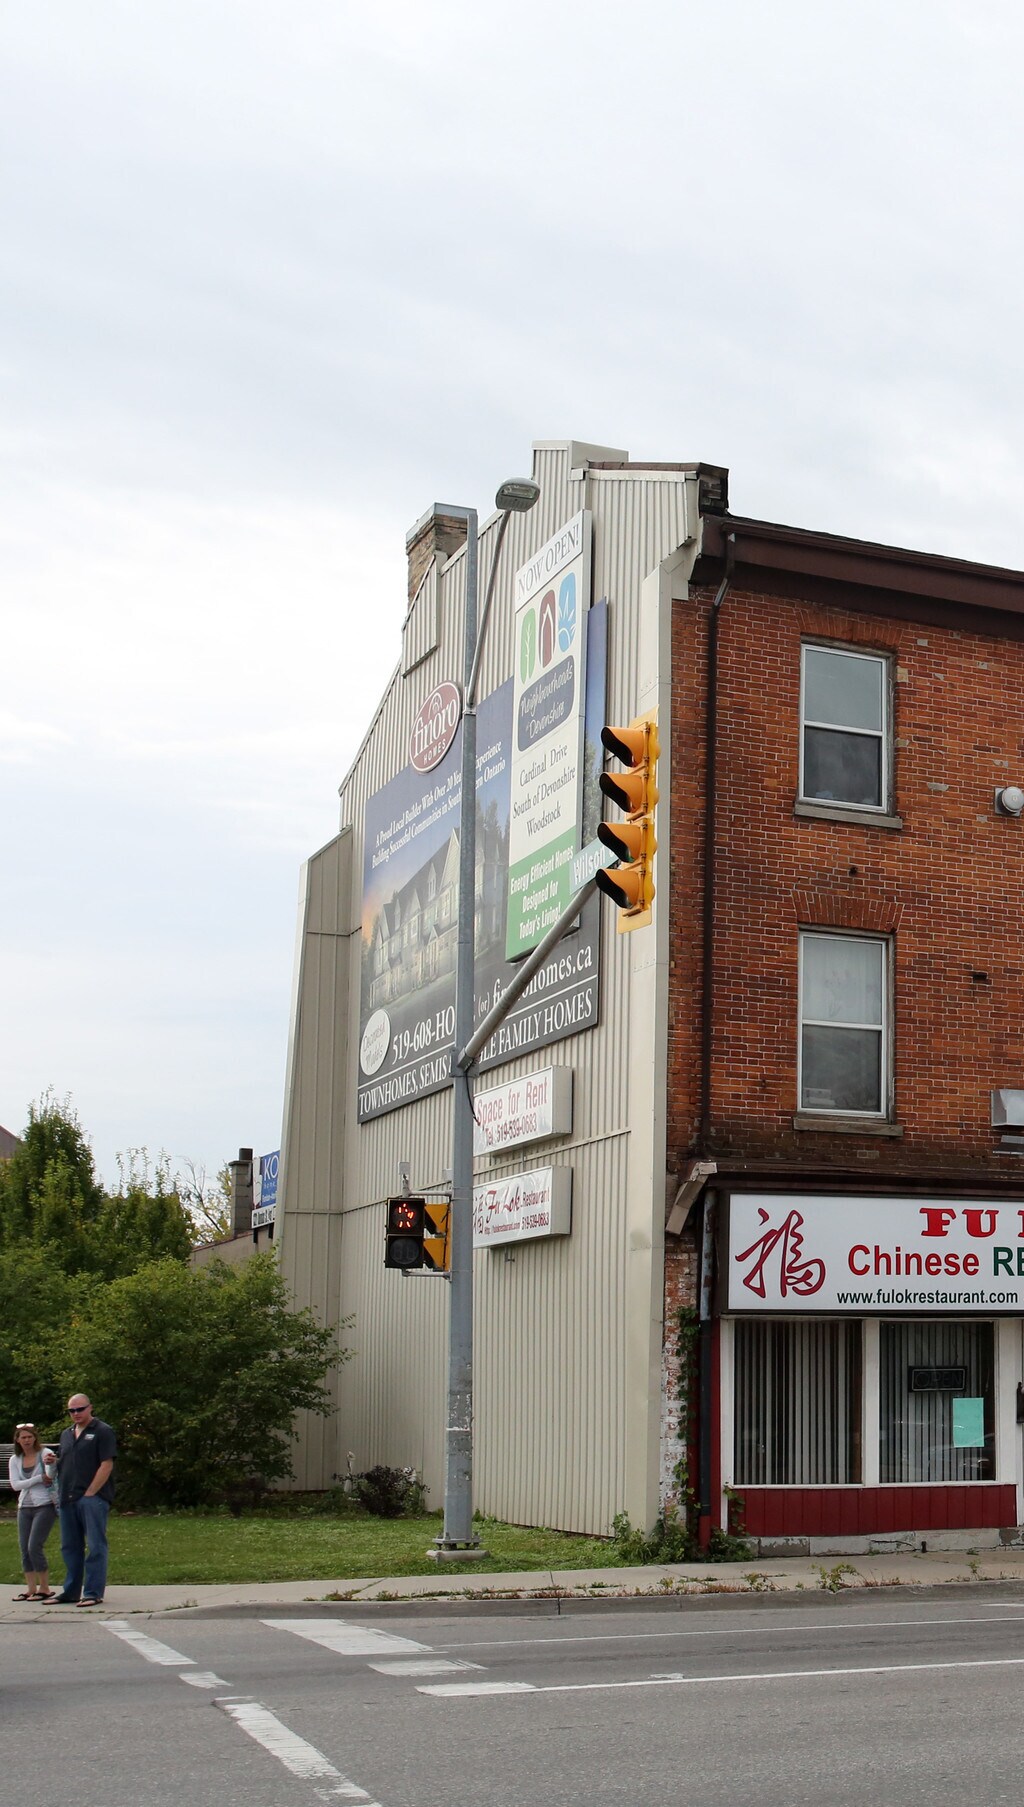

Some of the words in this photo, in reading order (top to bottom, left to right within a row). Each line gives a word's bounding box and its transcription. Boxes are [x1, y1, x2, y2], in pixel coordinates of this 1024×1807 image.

[518, 556, 544, 600] NOW
[545, 523, 579, 572] OPEN!
[413, 699, 457, 759] finoro
[423, 739, 446, 765] HOMES
[520, 753, 547, 787] Cardinal
[550, 745, 568, 767] Drive
[371, 847, 390, 869] Building
[389, 826, 411, 856] Successful
[411, 807, 442, 838] Communities
[441, 801, 448, 815] in
[484, 757, 506, 783] Ontario
[512, 793, 532, 819] South
[532, 785, 541, 807] of
[541, 766, 576, 801] Devonshire
[380, 821, 393, 845] Proud
[393, 812, 405, 835] Local
[405, 802, 422, 825] Builder
[421, 790, 434, 811] With
[434, 785, 446, 801] Over
[526, 799, 562, 837] Woodstock
[510, 872, 530, 896] Energy
[530, 854, 555, 884] Efficient
[554, 845, 574, 869] Homes
[573, 845, 606, 885] Wilson
[522, 883, 549, 914] Designed
[549, 880, 559, 899] for
[519, 915, 541, 940] Today's
[541, 901, 561, 928] Living!
[478, 992, 490, 1017] (or)
[358, 1069, 419, 1116] TOWNHOMES,
[419, 1054, 448, 1090] SEMIS
[498, 1010, 543, 1056] FAMILY
[543, 988, 593, 1036] HOMES
[477, 1098, 503, 1125] Space
[508, 1088, 520, 1116] for
[525, 1077, 548, 1110] Rent
[919, 1207, 1000, 1238] FU
[847, 1243, 980, 1277] Chinese
[836, 1287, 1019, 1304] www.fulokrestaurant.com
